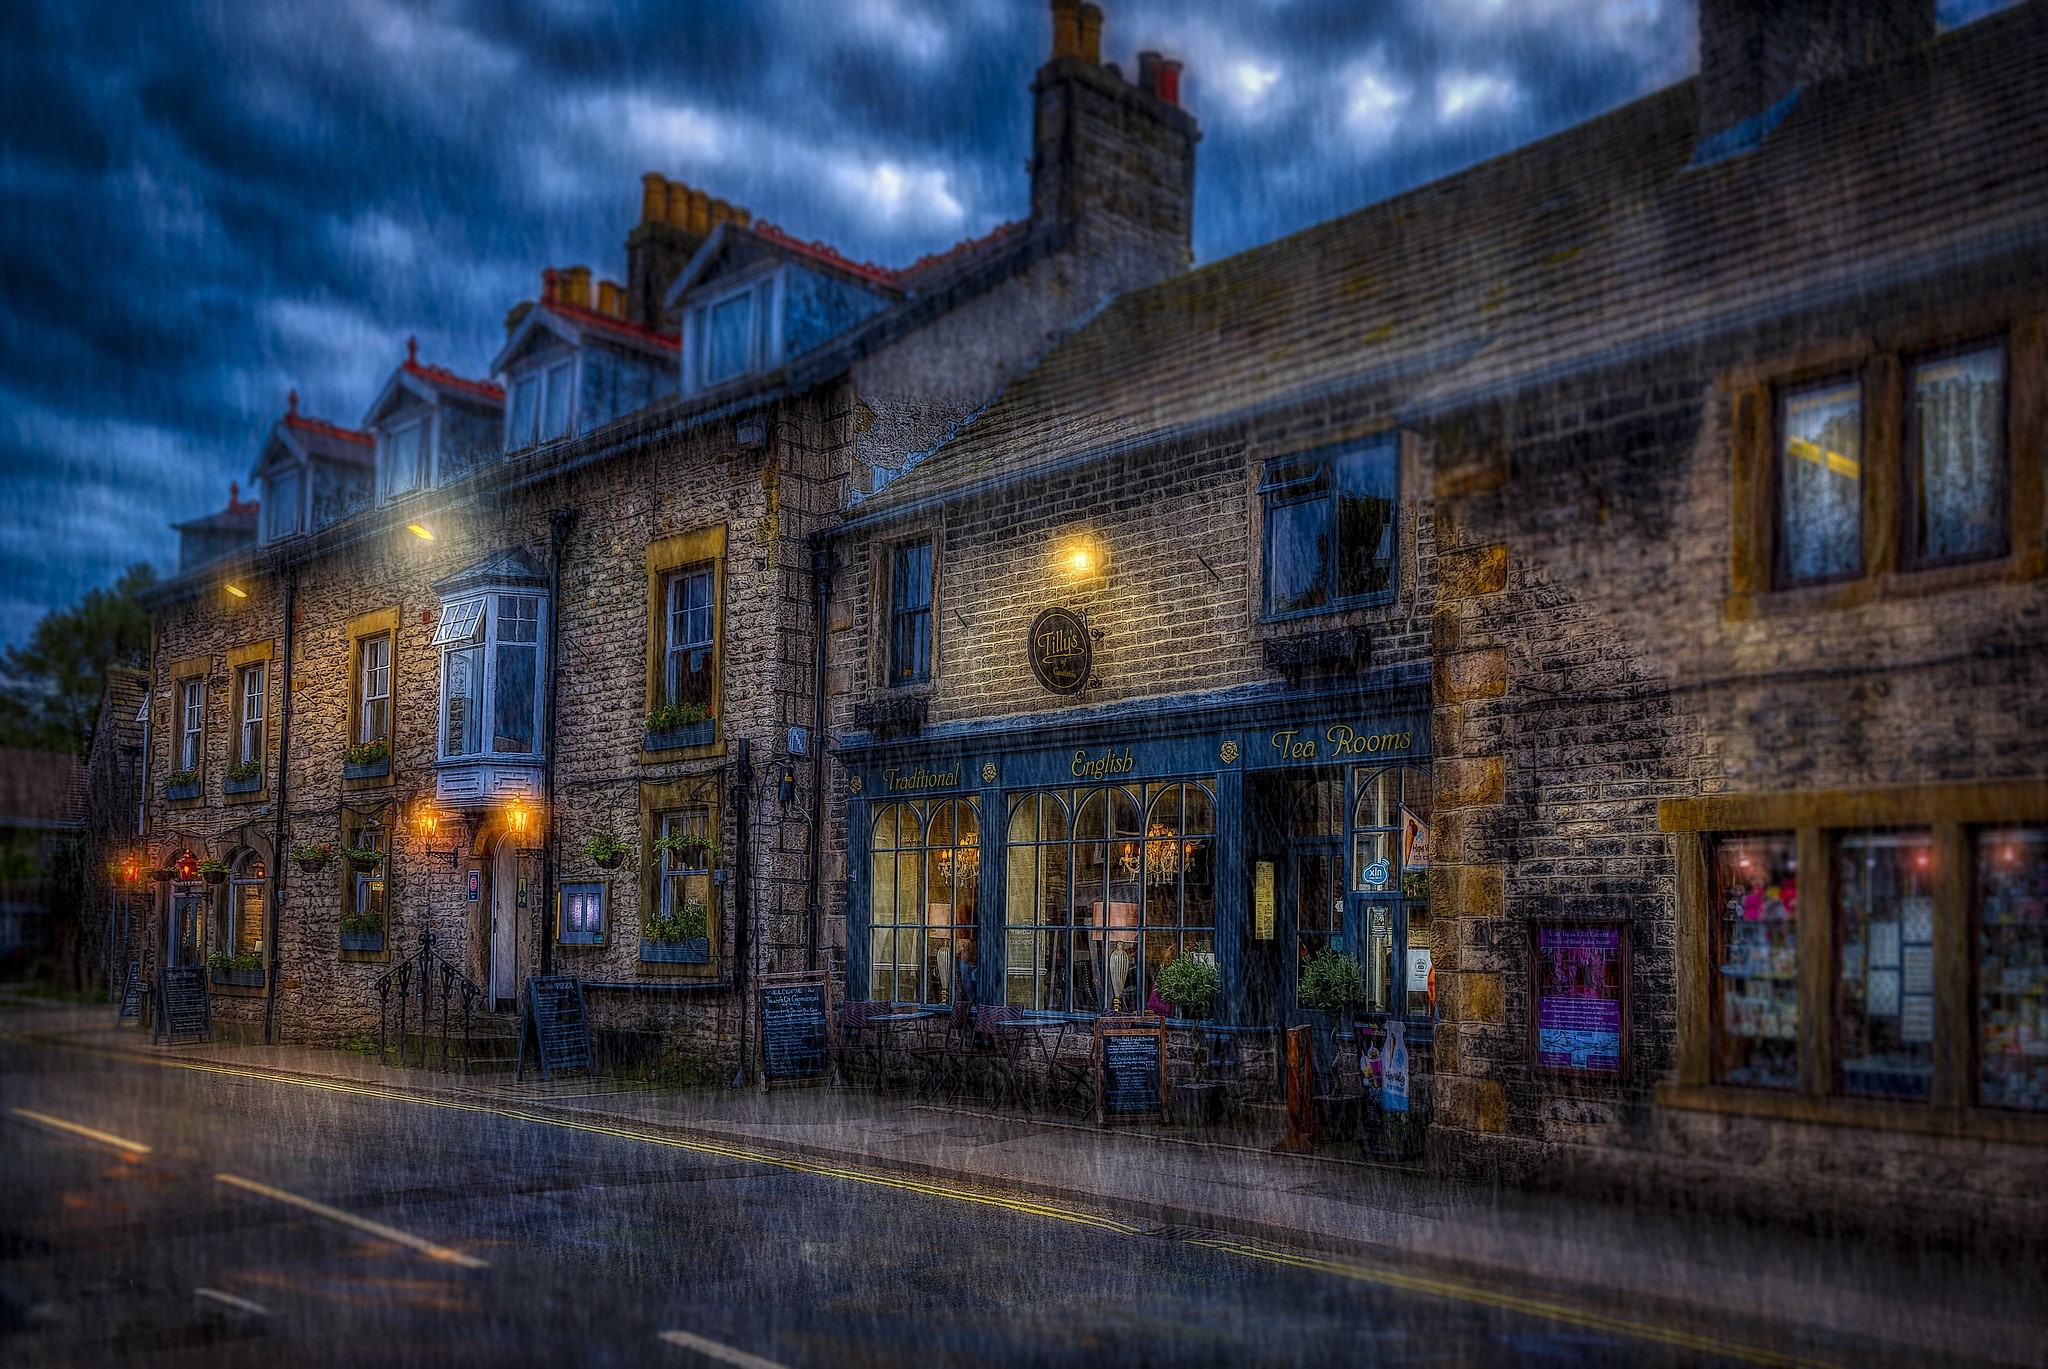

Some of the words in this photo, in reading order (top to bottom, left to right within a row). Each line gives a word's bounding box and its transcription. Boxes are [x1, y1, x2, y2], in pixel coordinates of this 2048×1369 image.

[1037, 629, 1081, 659] Tilly's
[882, 763, 960, 792] Traditional
[1071, 747, 1133, 781] English
[1271, 729, 1317, 760] Tea
[1325, 724, 1412, 757] Rooms
[555, 982, 574, 990] PIZZA
